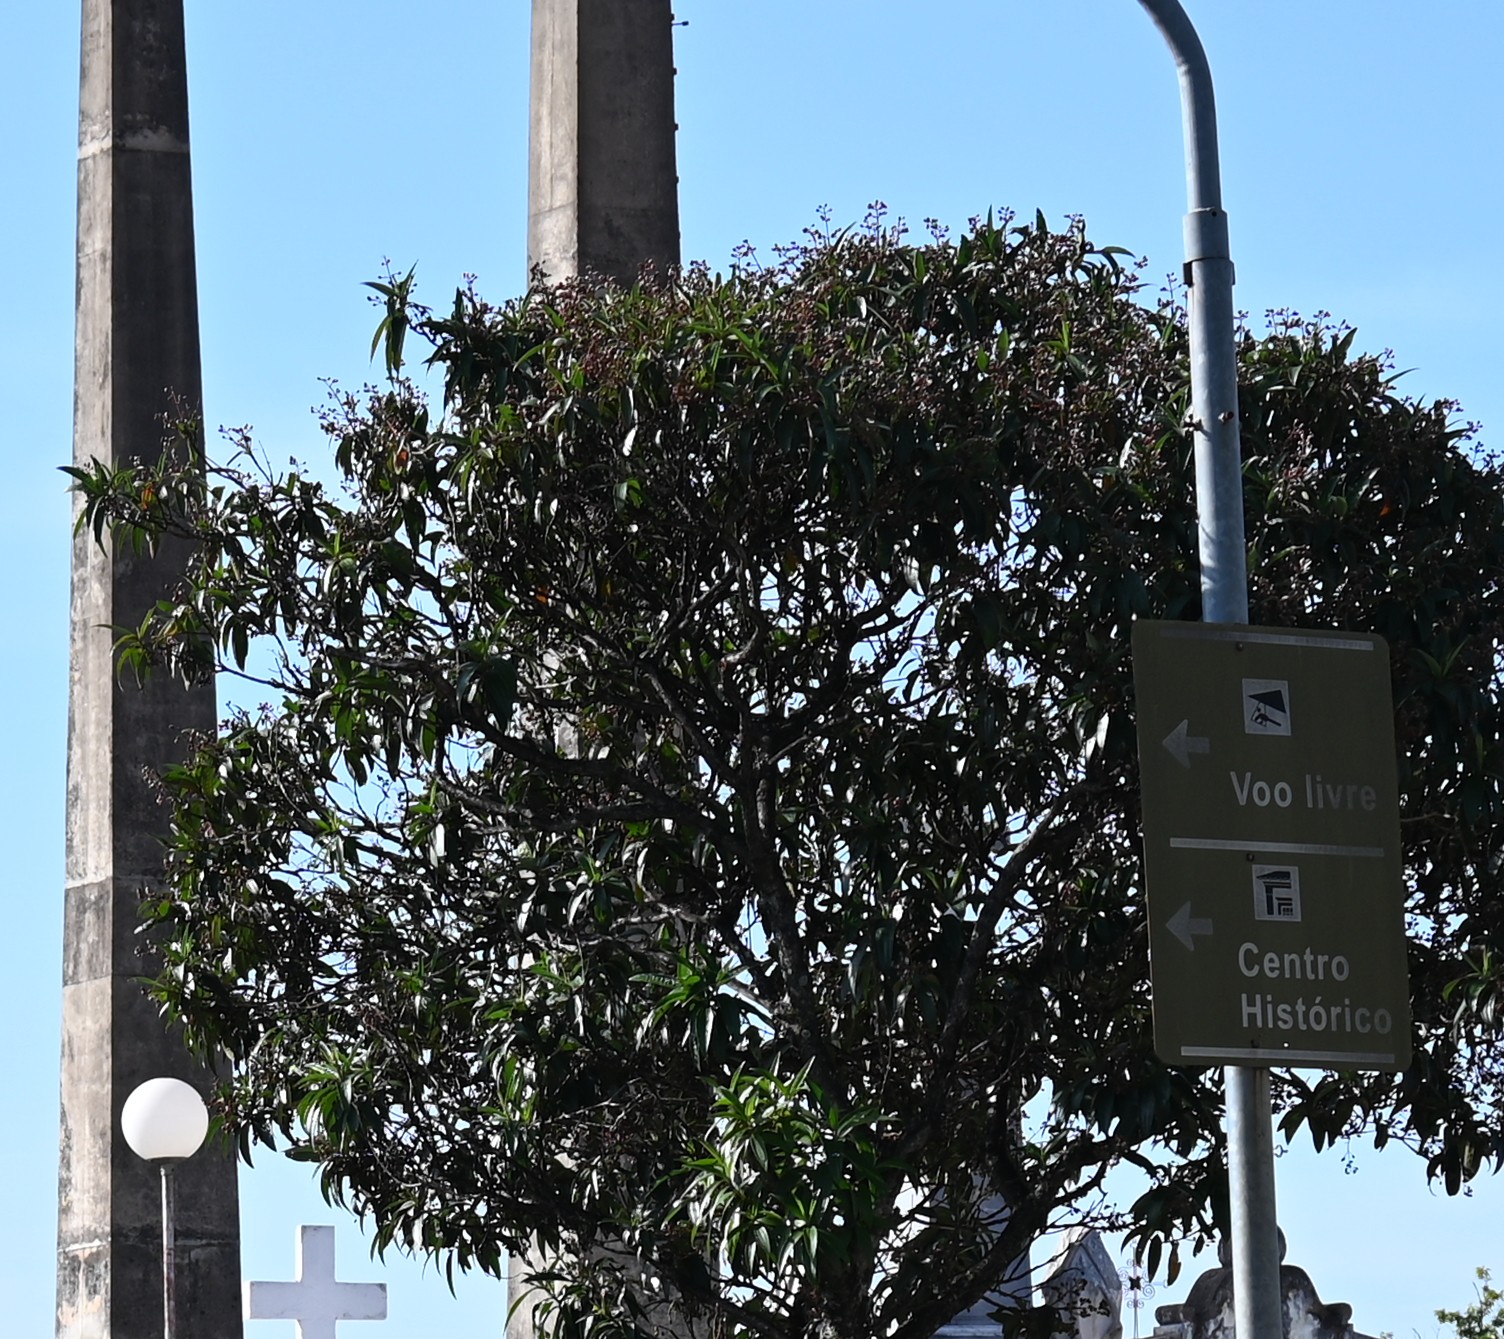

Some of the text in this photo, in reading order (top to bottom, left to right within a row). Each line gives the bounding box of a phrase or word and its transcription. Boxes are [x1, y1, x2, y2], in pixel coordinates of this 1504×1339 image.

[1230, 770, 1377, 810] Voo livre
[1238, 942, 1350, 982] Centro
[1241, 993, 1392, 1035] Histórico
